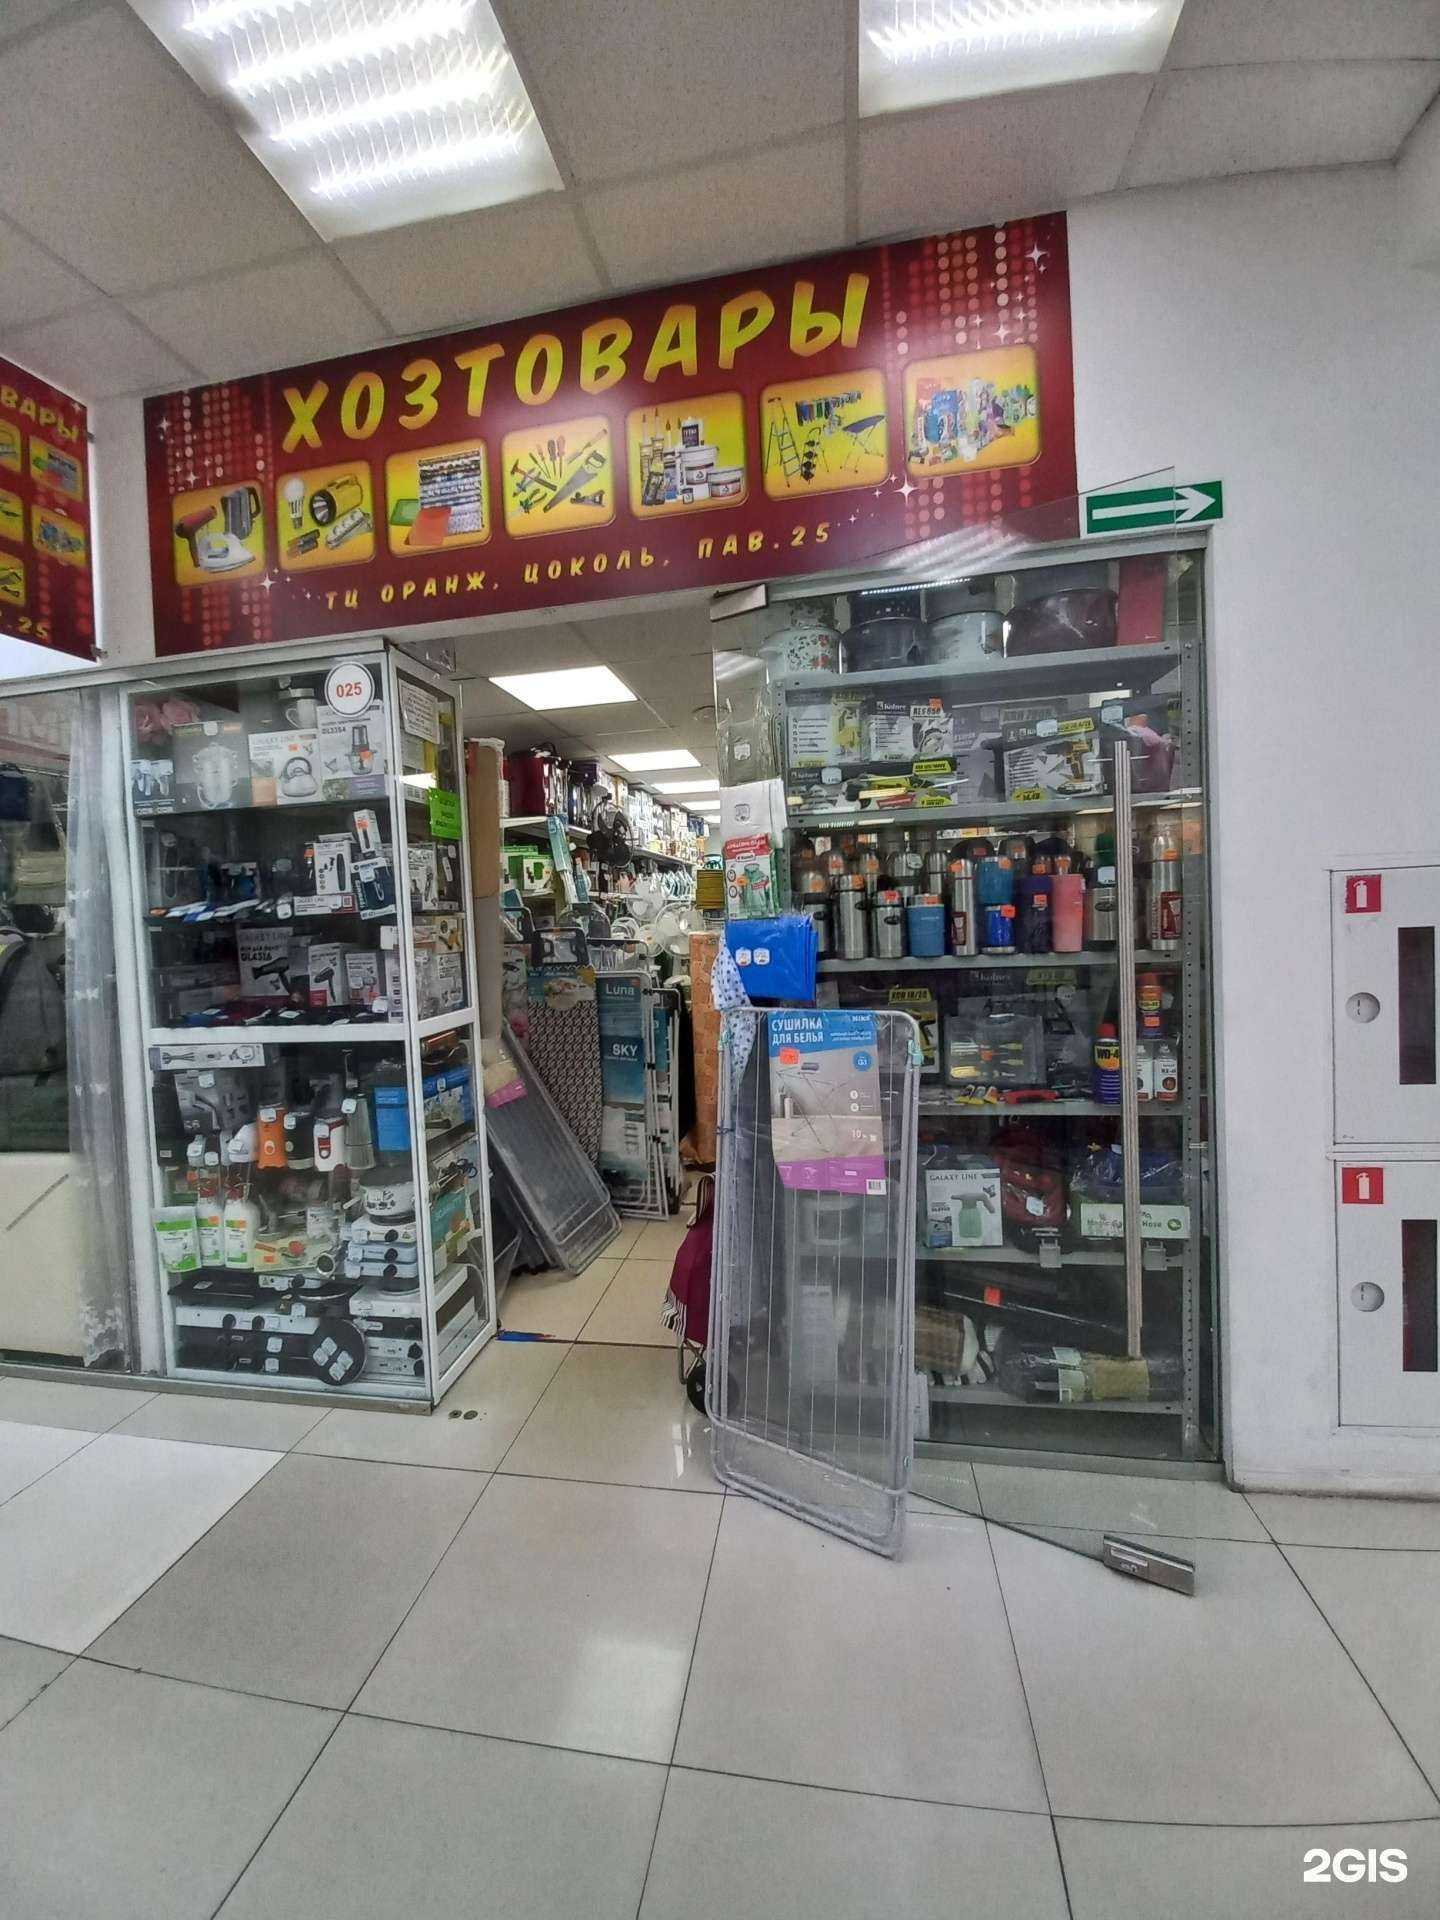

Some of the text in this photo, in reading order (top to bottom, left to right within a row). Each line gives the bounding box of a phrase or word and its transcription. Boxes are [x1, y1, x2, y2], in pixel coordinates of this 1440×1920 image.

[282, 273, 869, 453] ХОЗТОВАРЫ
[326, 521, 832, 610] ТЦ ОРАНЖ, ЦОКОЛЬ, ПАВ.25
[336, 681, 362, 698] 025
[606, 984, 635, 996] Luna
[771, 1017, 823, 1032] СУШИЛКА
[772, 1033, 792, 1046] ДЛЯ
[793, 1031, 824, 1043] БЕЛЬЯ
[612, 1044, 638, 1056] SKY
[1097, 1047, 1120, 1060] WD-4
[929, 1173, 958, 1181] GALAXY
[1142, 1220, 1162, 1228] Hose
